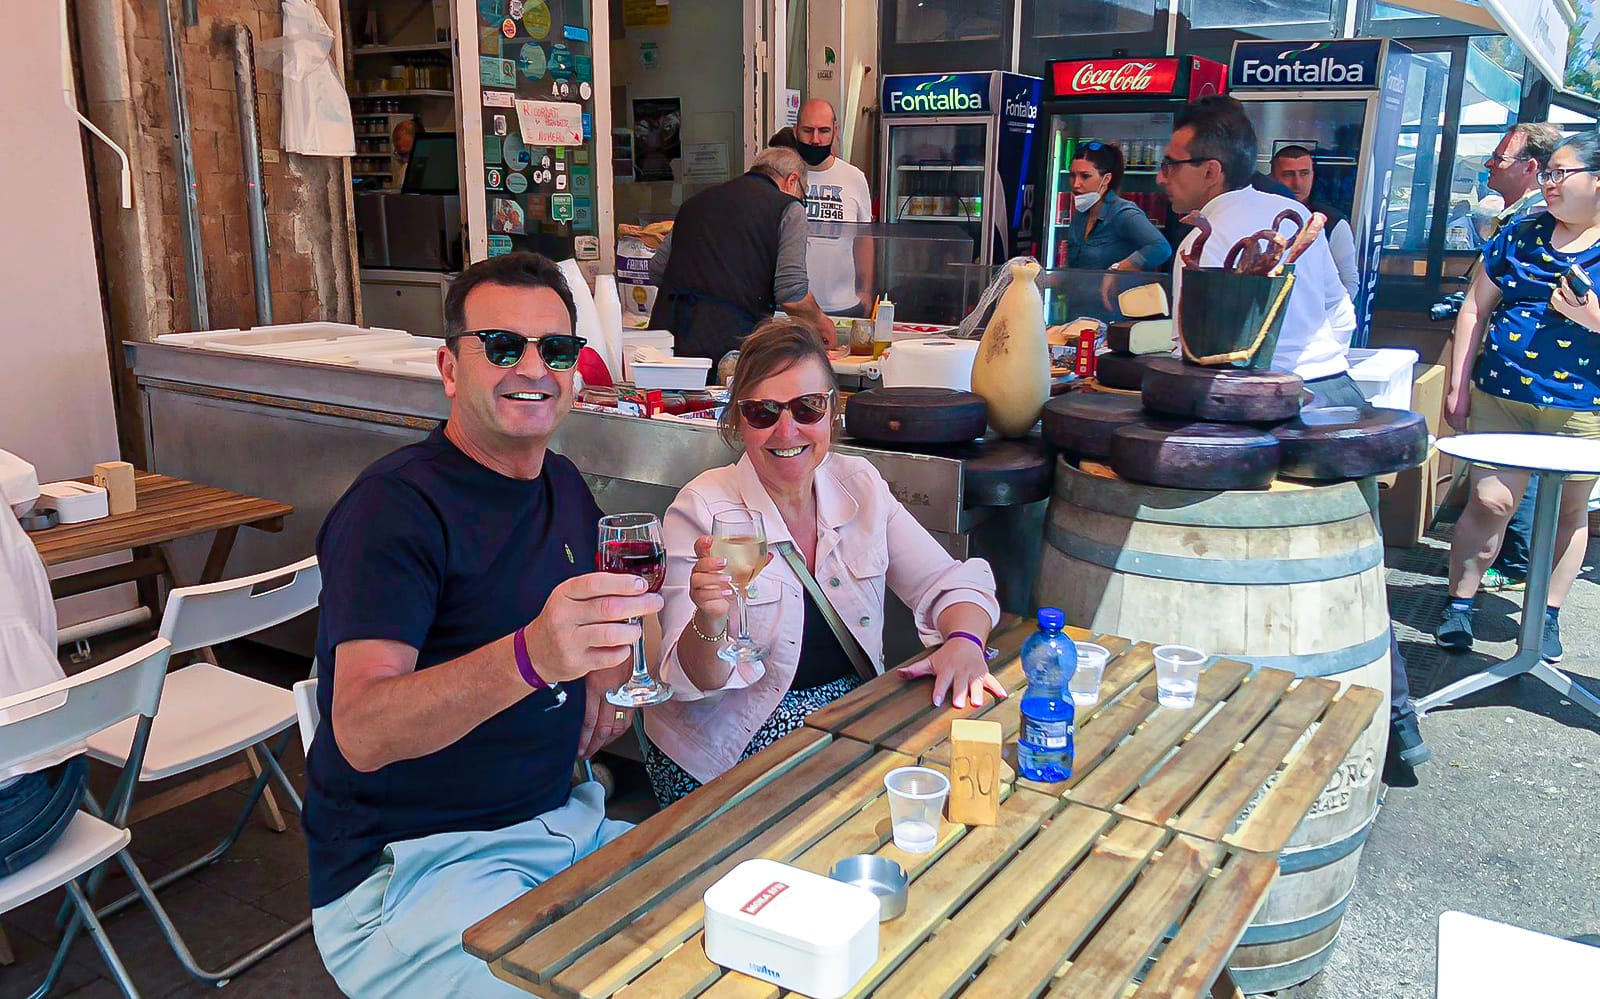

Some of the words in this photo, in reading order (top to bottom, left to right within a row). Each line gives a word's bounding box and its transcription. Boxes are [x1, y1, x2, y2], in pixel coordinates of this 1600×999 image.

[1072, 63, 1156, 91] Coca-Cola
[1242, 58, 1363, 83] Fontalba
[890, 88, 982, 112] Fontalba
[1006, 99, 1037, 119] Fontalba
[820, 202, 844, 211] SINCE
[820, 209, 844, 220] 1948
[1361, 171, 1392, 348] ontalba
